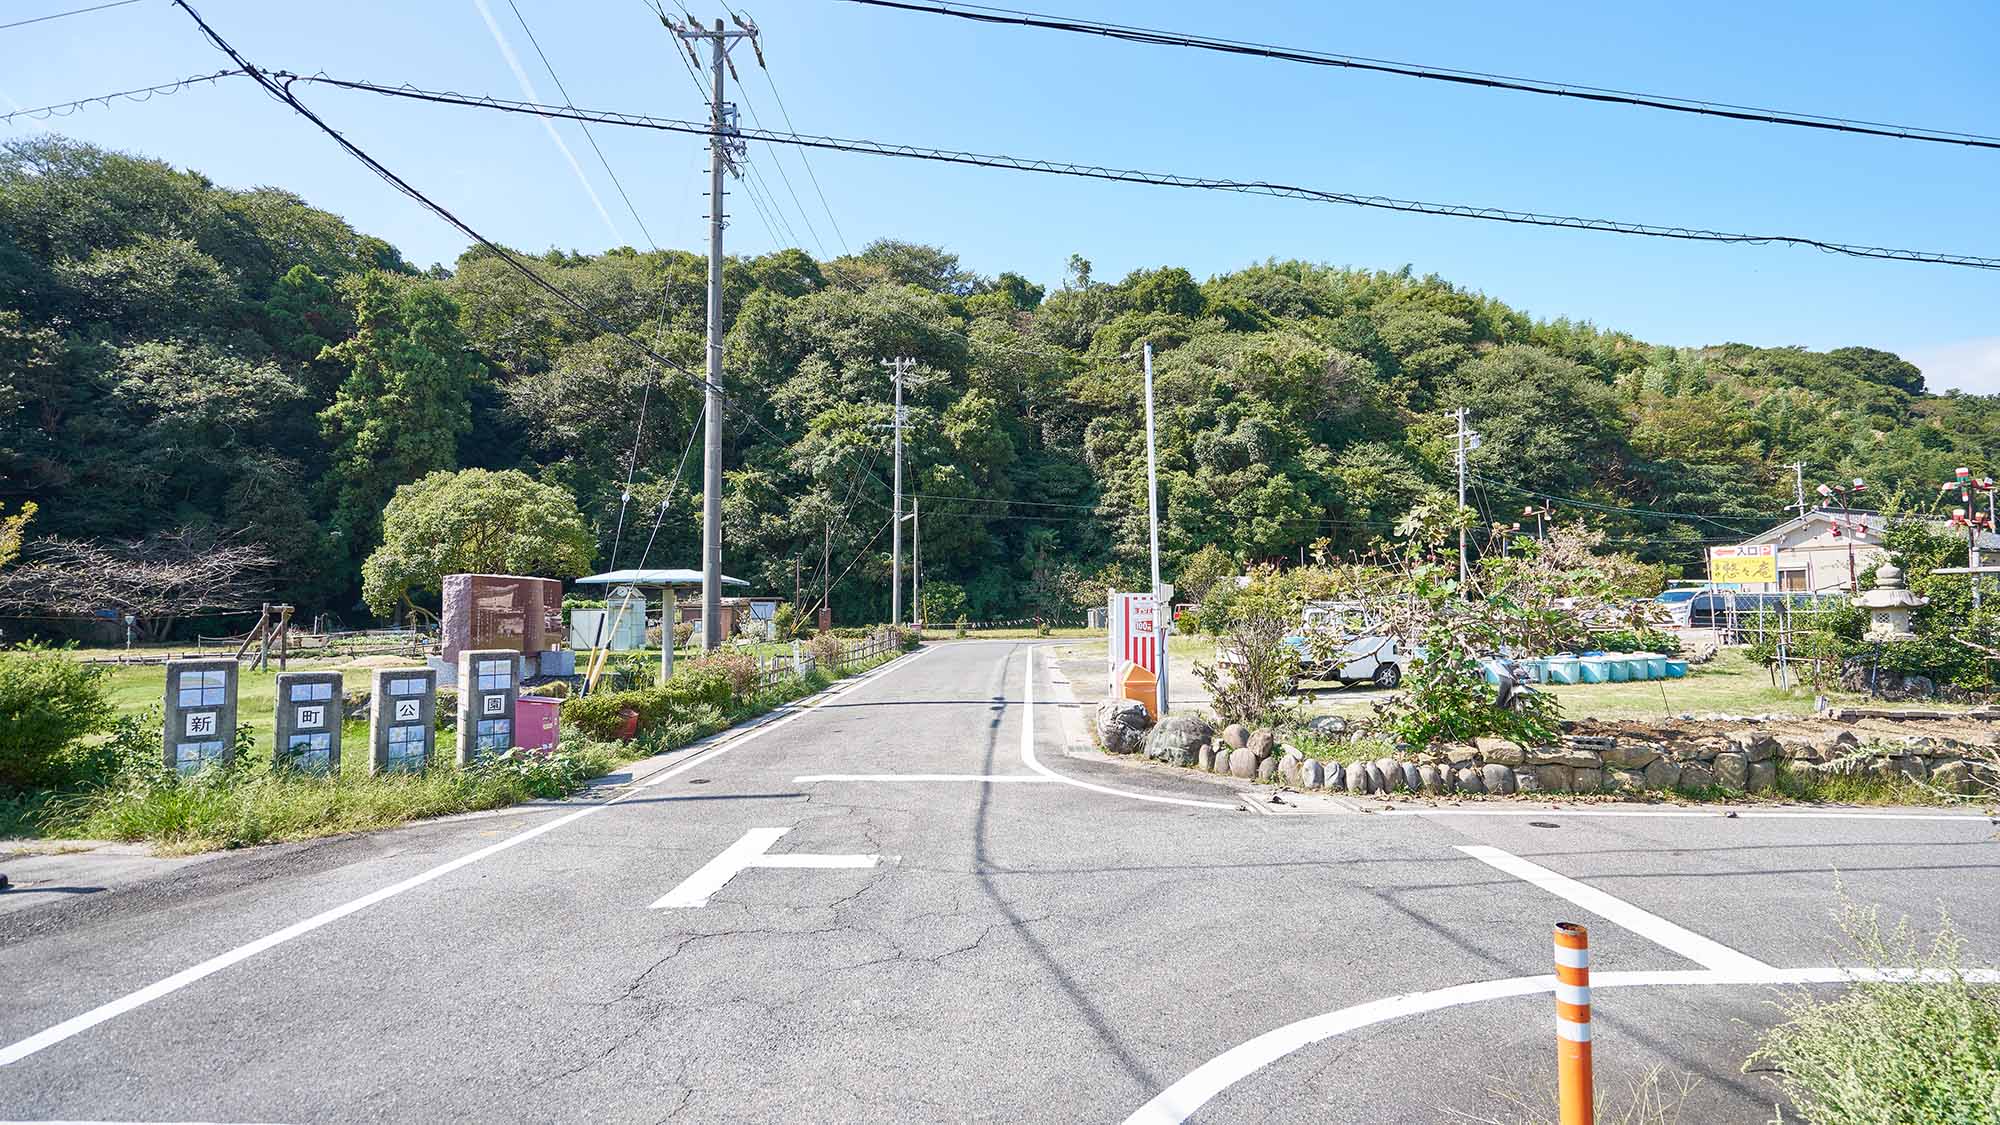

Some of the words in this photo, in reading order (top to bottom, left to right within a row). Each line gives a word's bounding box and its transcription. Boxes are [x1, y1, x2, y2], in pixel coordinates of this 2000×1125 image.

[1737, 546, 1758, 556] 入口
[191, 716, 212, 733] 新
[302, 710, 320, 724] 町
[399, 704, 416, 717] 公
[487, 697, 502, 711] 園
